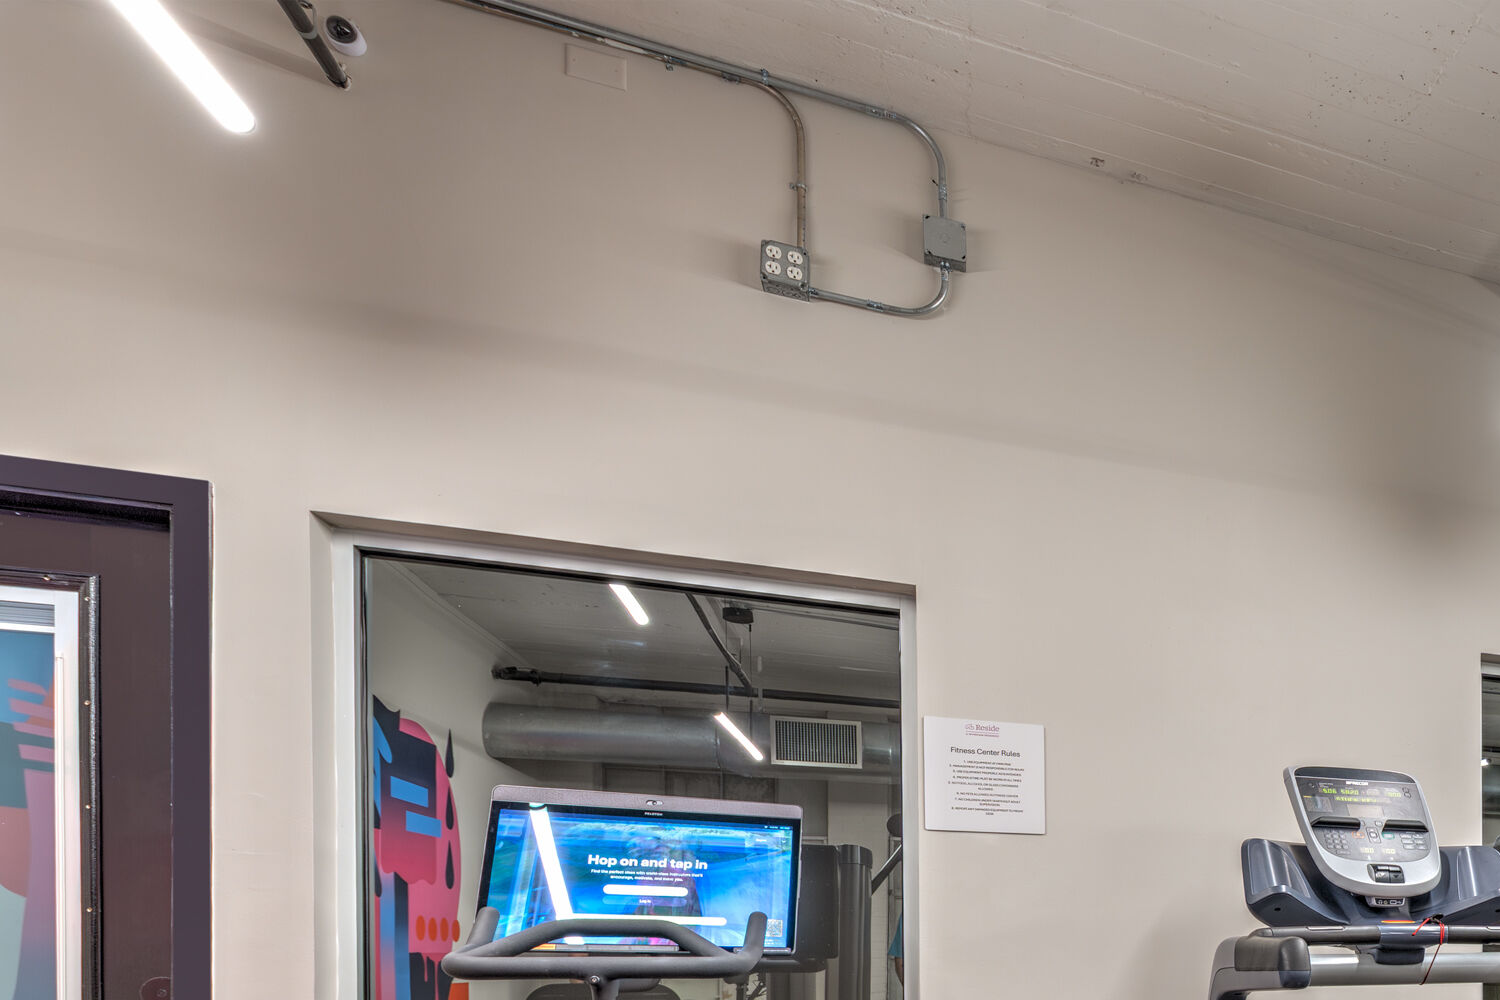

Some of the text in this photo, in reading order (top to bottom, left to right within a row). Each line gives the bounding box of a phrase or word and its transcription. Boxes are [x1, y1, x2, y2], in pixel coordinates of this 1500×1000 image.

[975, 724, 1000, 732] Reside
[950, 746, 1021, 758] Fitness Center Rules
[587, 854, 708, 871] Hop on and tap in
